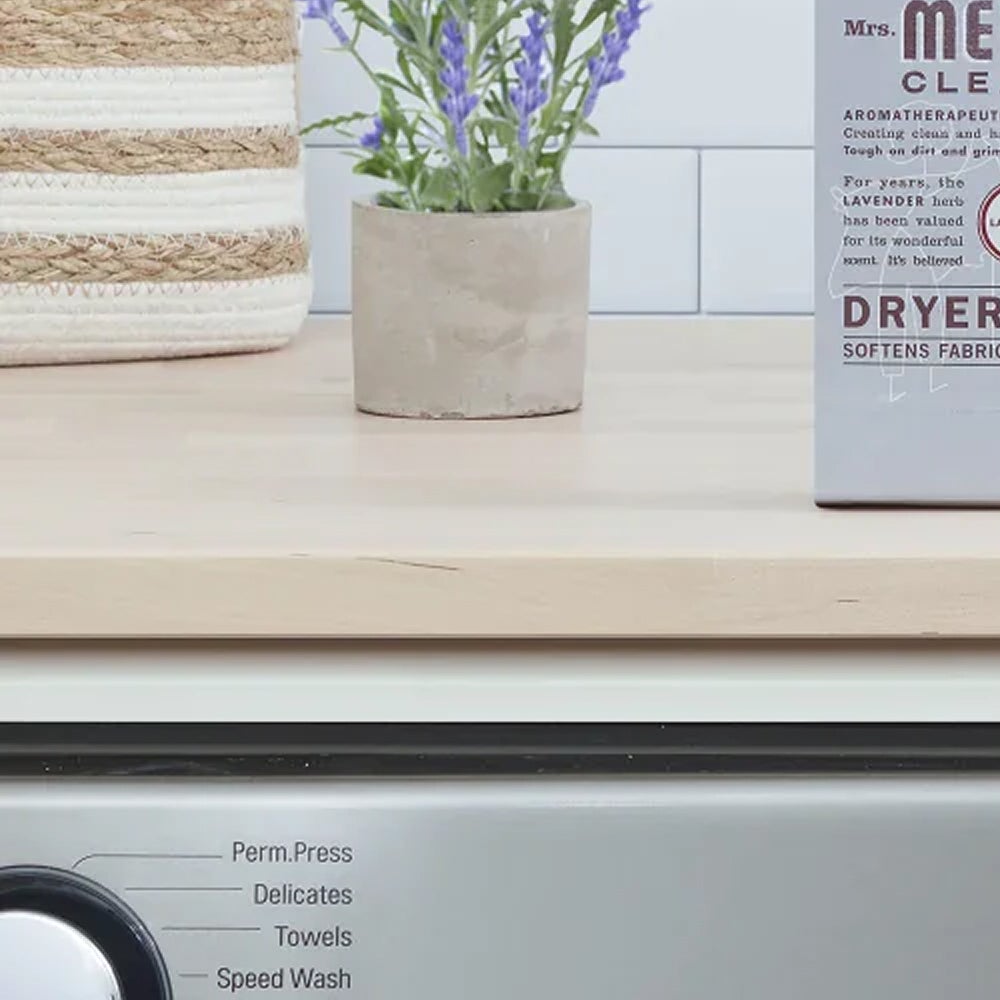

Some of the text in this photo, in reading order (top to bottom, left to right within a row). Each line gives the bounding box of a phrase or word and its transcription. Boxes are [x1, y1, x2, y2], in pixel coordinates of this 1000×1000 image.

[844, 19, 896, 37] Mrs.
[843, 127, 905, 141] Creating
[911, 128, 949, 139] clean
[955, 128, 982, 139] and
[843, 145, 883, 158] Tough
[889, 147, 905, 156] on
[911, 145, 935, 156] dirt
[941, 145, 967, 156] and
[843, 175, 965, 191] For years, the
[843, 195, 965, 207] LAVENDER herb
[843, 215, 964, 227] has been valued
[843, 235, 964, 247] for its wonderful
[913, 255, 964, 267] believed
[843, 342, 930, 359] SOFTENS
[254, 883, 353, 905] Delicates
[274, 925, 352, 947] Towels
[216, 967, 351, 993] Speed Wash
